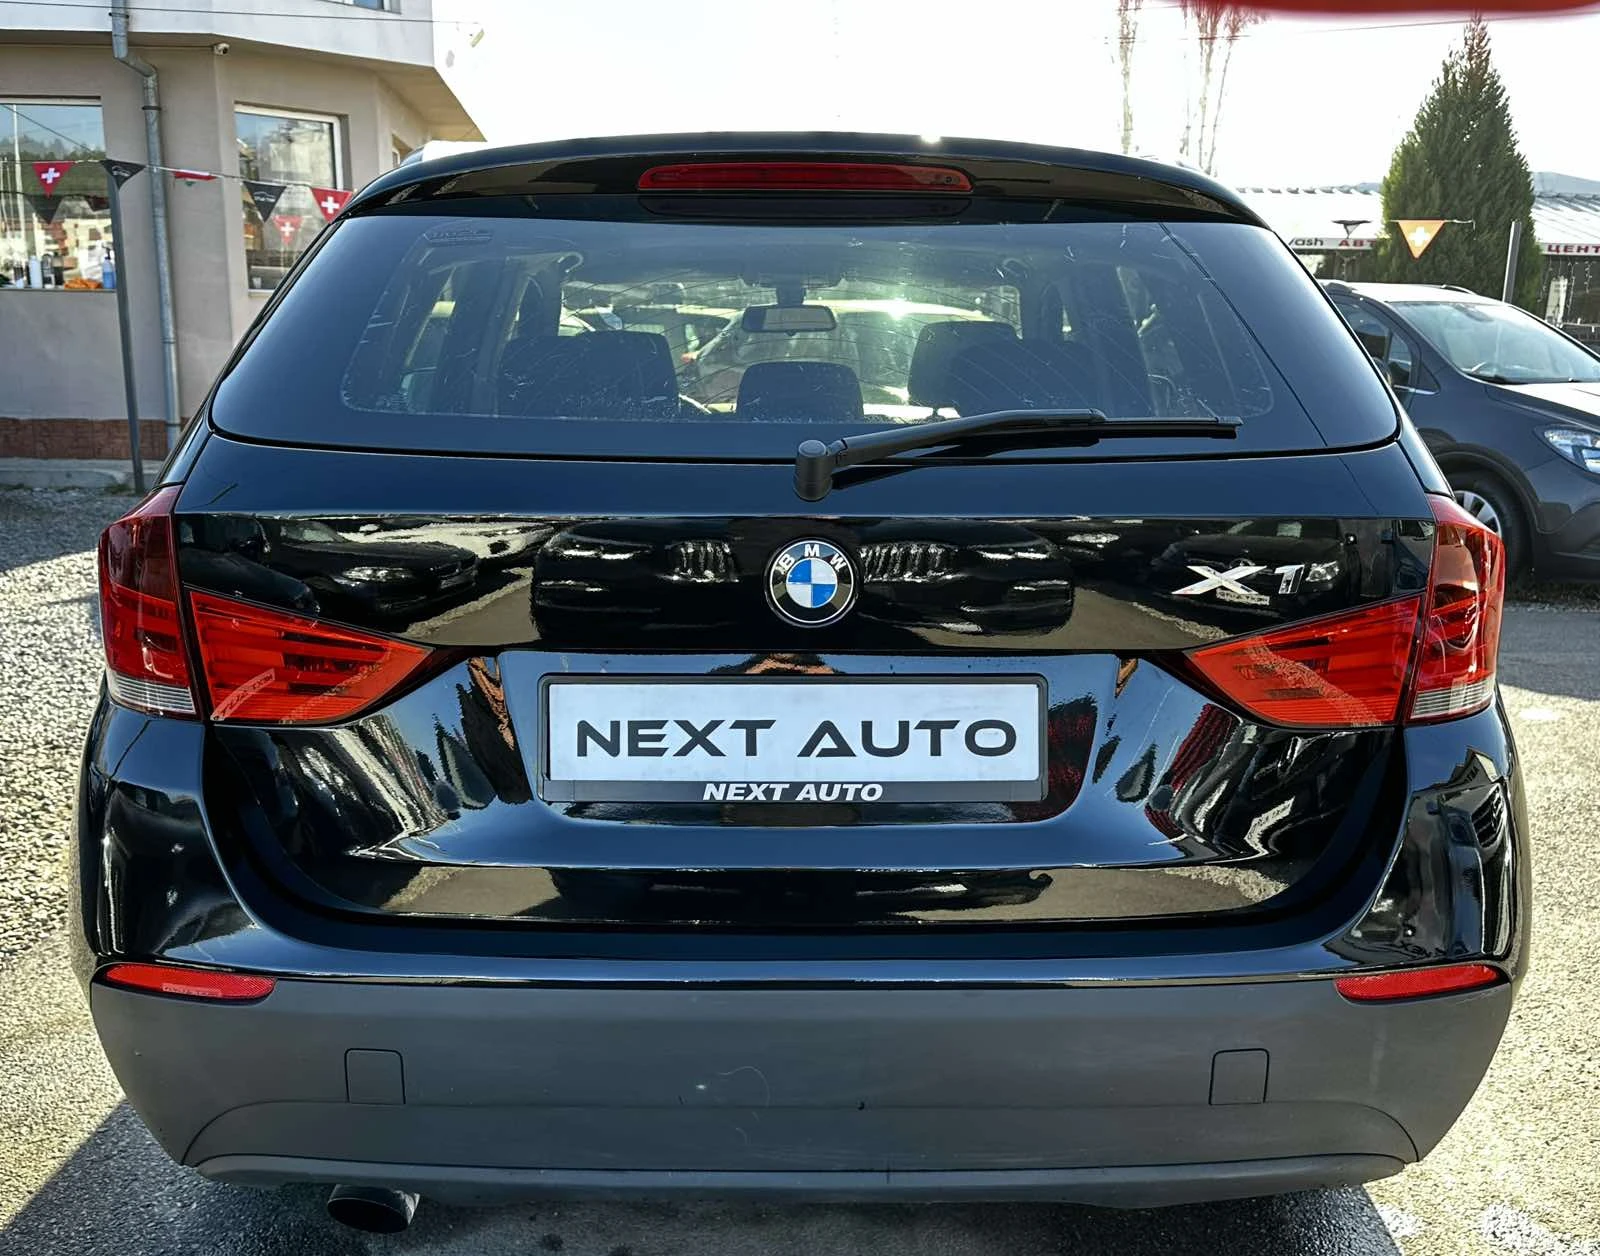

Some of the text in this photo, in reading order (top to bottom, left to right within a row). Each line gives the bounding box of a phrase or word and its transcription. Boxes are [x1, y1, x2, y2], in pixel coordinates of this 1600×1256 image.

[775, 543, 846, 575] BMW
[1171, 564, 1305, 595] X1
[577, 719, 1017, 757] NEXT AUTO
[702, 783, 884, 801] NEXT AUTO
